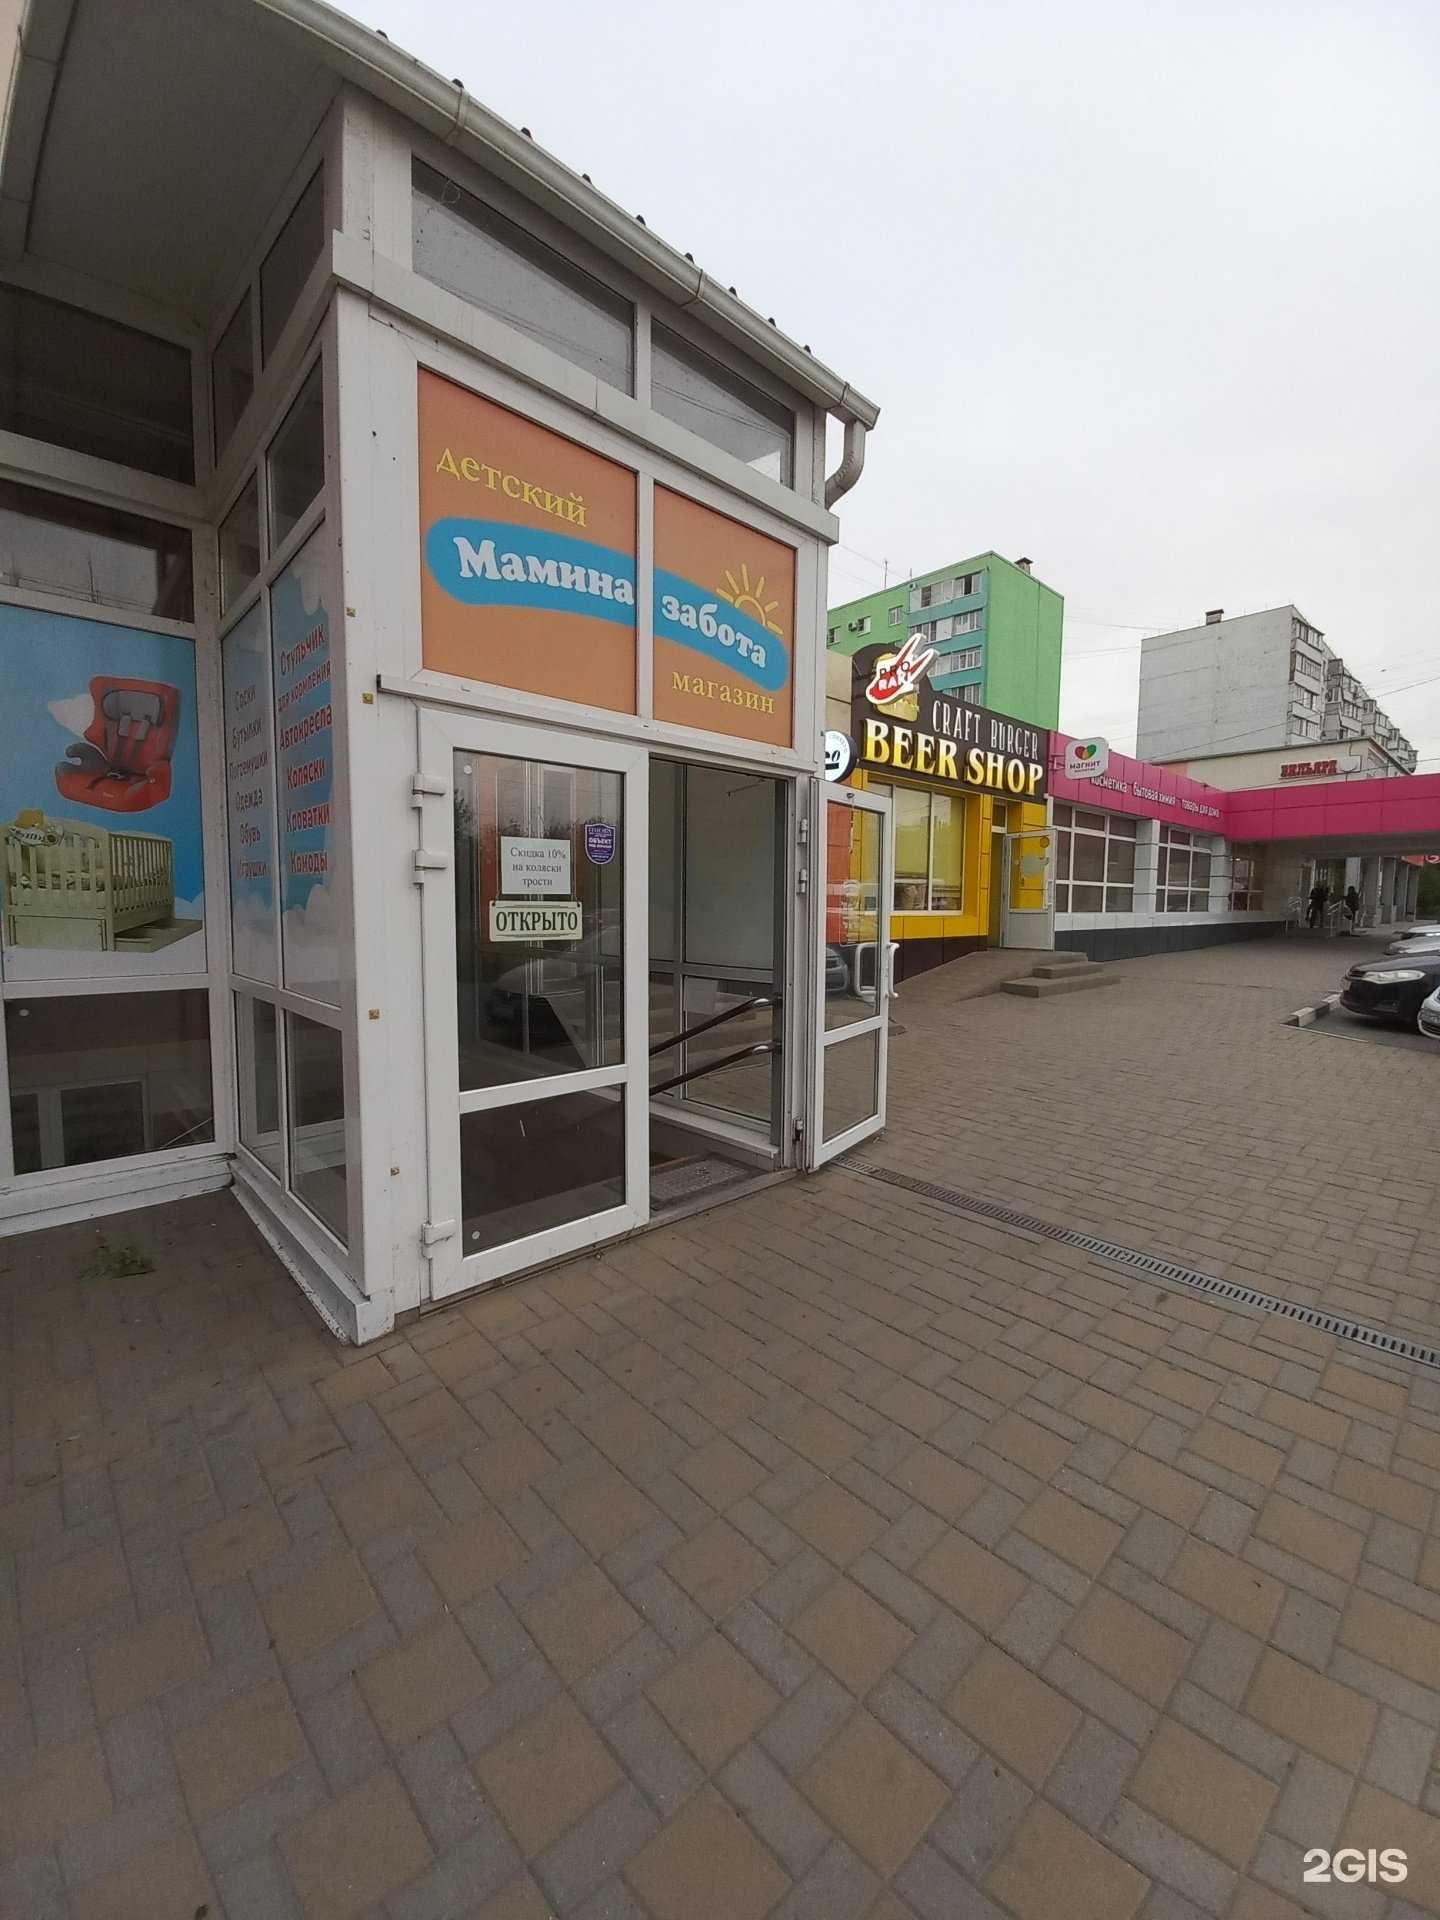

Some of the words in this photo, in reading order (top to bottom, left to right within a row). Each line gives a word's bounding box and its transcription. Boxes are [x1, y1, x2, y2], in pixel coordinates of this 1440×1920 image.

[453, 536, 636, 605] Мамина
[661, 595, 767, 668] забота
[280, 624, 325, 677] Стульчик
[672, 671, 775, 714] магазин
[280, 704, 332, 751] Автокресла
[932, 700, 981, 744] CRAFT
[991, 718, 1039, 761] BURGER
[864, 718, 958, 779] BEER
[967, 748, 1043, 796] SHOP
[287, 758, 326, 791] Коляски
[287, 804, 331, 836] Кроватки
[290, 850, 329, 873] Комоды
[510, 847, 545, 858] Скидка
[548, 848, 566, 859] 10%
[512, 864, 523, 872] на
[526, 864, 562, 873] коляски
[522, 878, 553, 888] трости
[495, 911, 578, 932] ОТКРЫТО
